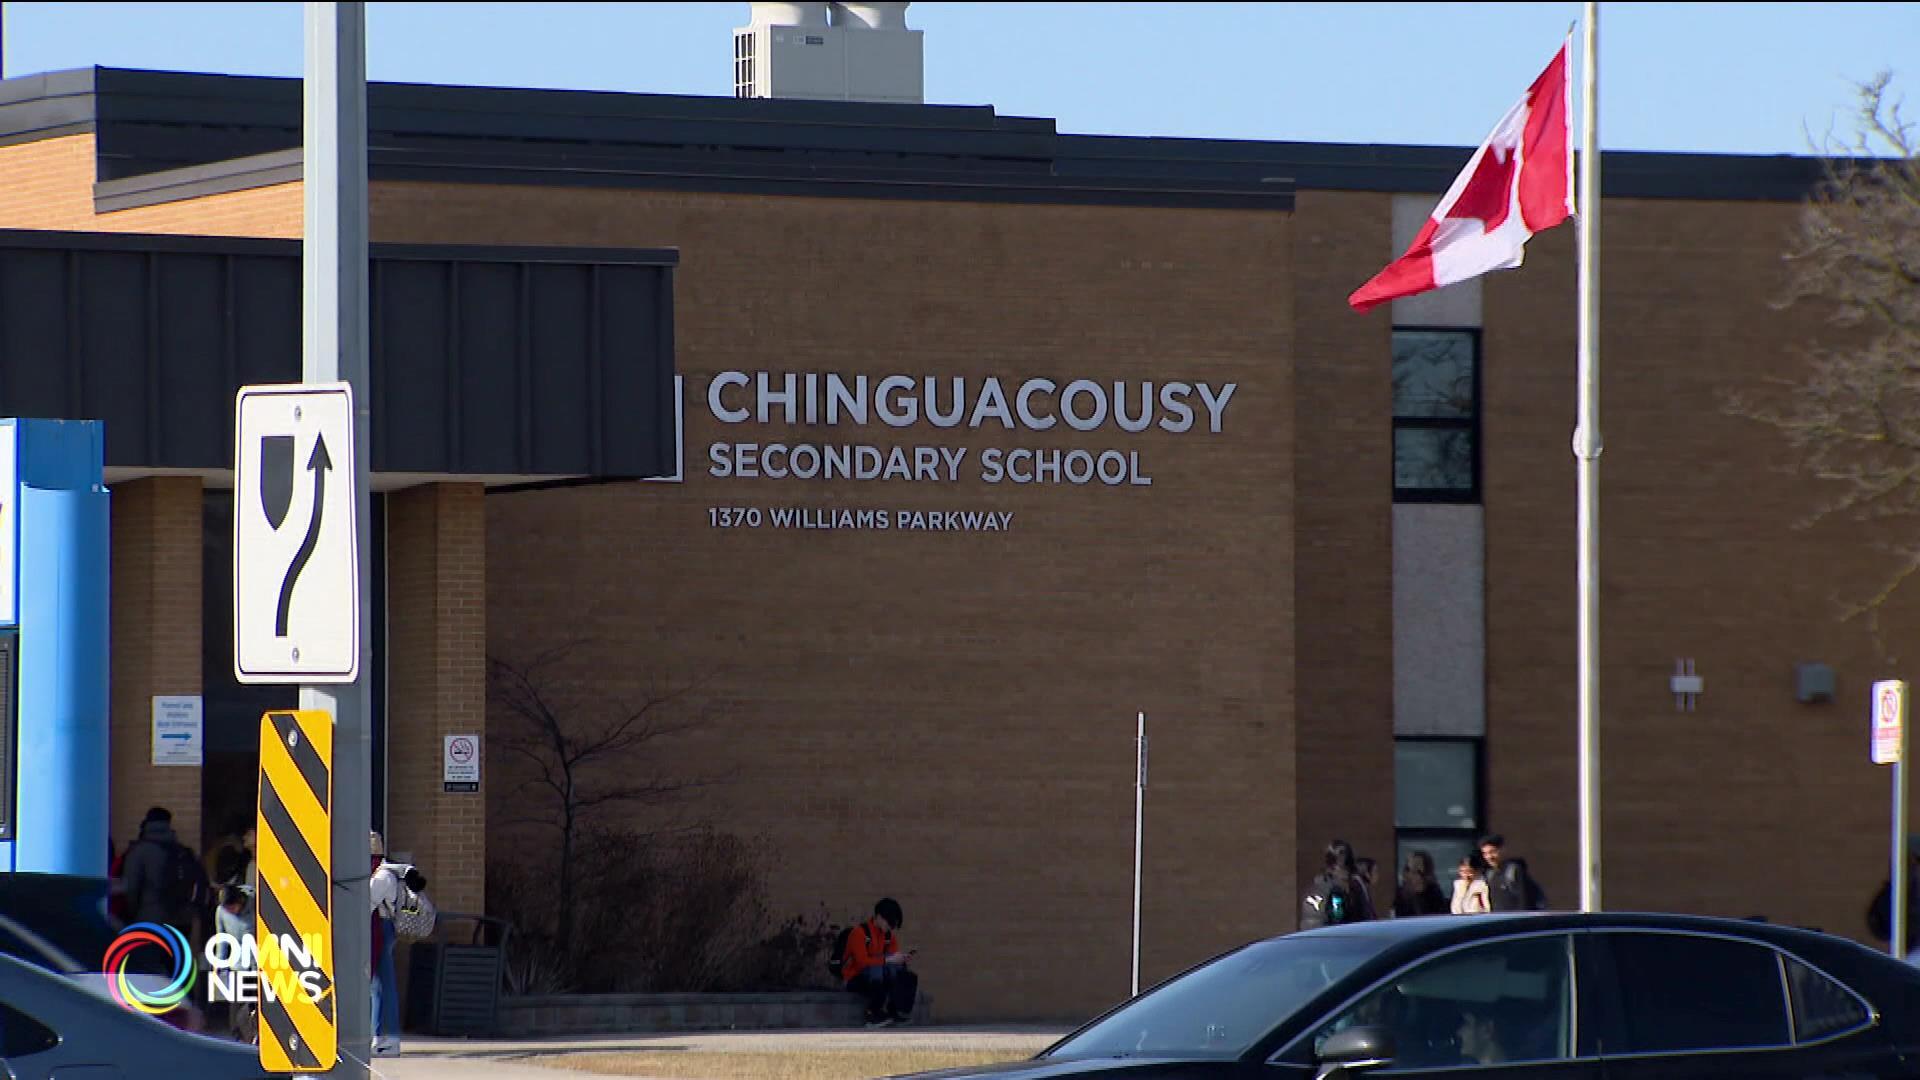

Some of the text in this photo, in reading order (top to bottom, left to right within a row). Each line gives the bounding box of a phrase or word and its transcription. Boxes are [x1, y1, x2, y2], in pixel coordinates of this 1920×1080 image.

[708, 371, 1238, 433] CHINGUACOUSY
[708, 442, 1153, 486] SECONDARY SCHOOL
[708, 507, 1014, 532] 1370 WILLIAMS PARKWAY
